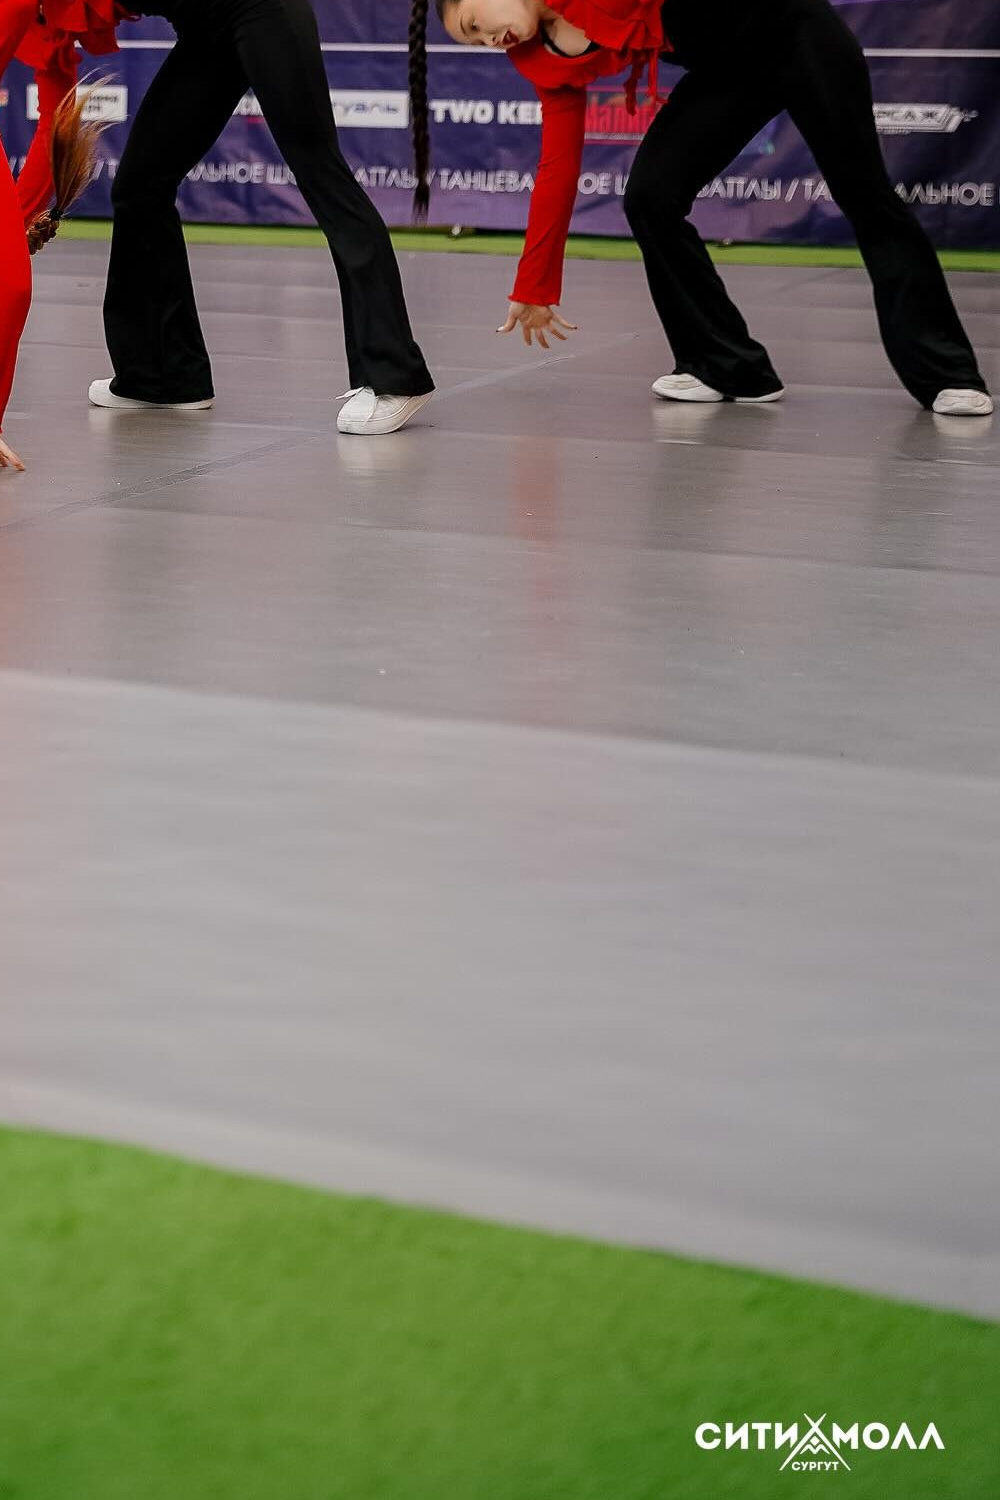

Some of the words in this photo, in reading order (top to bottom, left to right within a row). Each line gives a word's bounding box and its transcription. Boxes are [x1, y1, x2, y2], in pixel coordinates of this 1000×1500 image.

[429, 99, 494, 124] TWO
[497, 100, 542, 125] KE
[696, 176, 781, 201] АТТЛЫ
